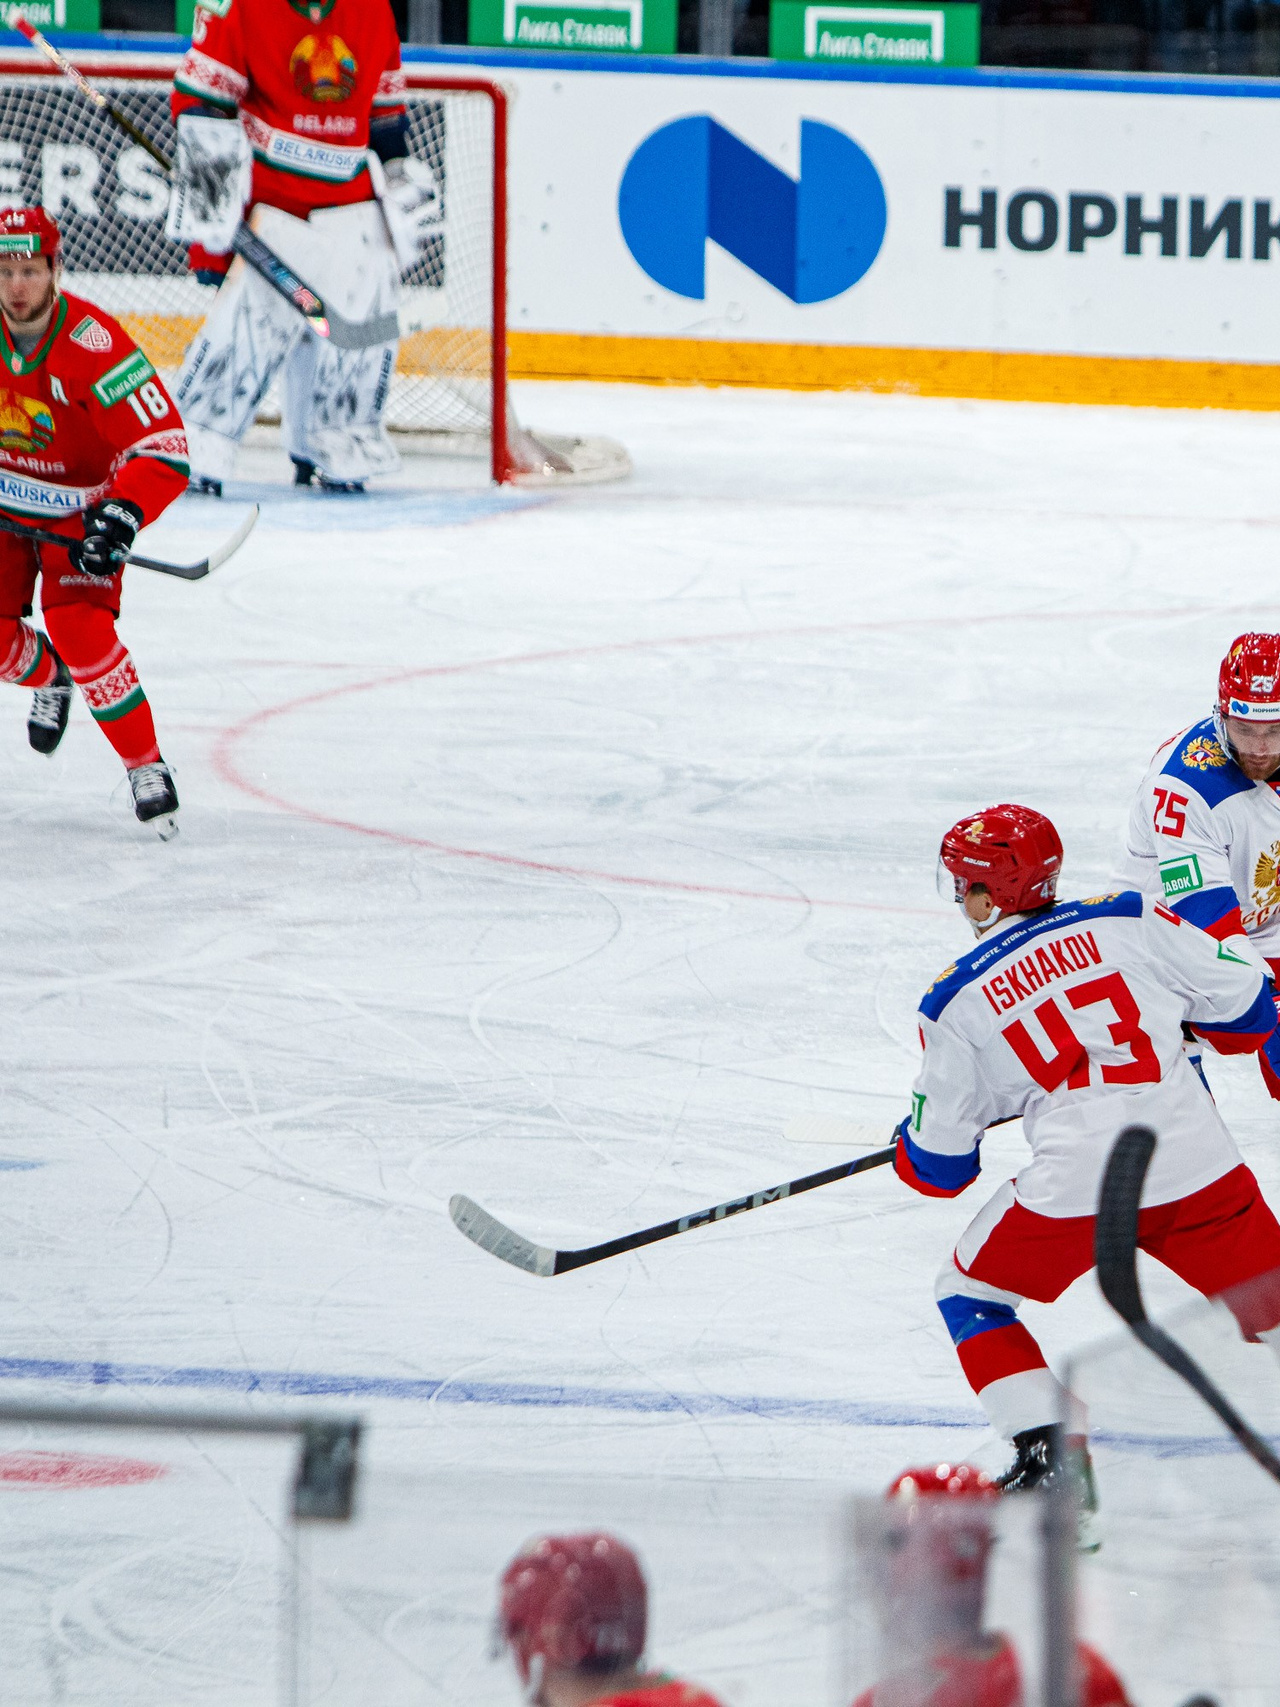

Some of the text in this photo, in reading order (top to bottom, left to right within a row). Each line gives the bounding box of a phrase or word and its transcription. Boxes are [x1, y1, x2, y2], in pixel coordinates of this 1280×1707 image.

[126, 380, 170, 429] 18
[1250, 675, 1274, 694] 25
[962, 856, 991, 868] BAUER
[1162, 876, 1192, 894] ТАВОК
[981, 931, 1103, 1016] ISKHAKOV
[1001, 971, 1162, 1094] 43
[678, 1181, 790, 1233] CCM
